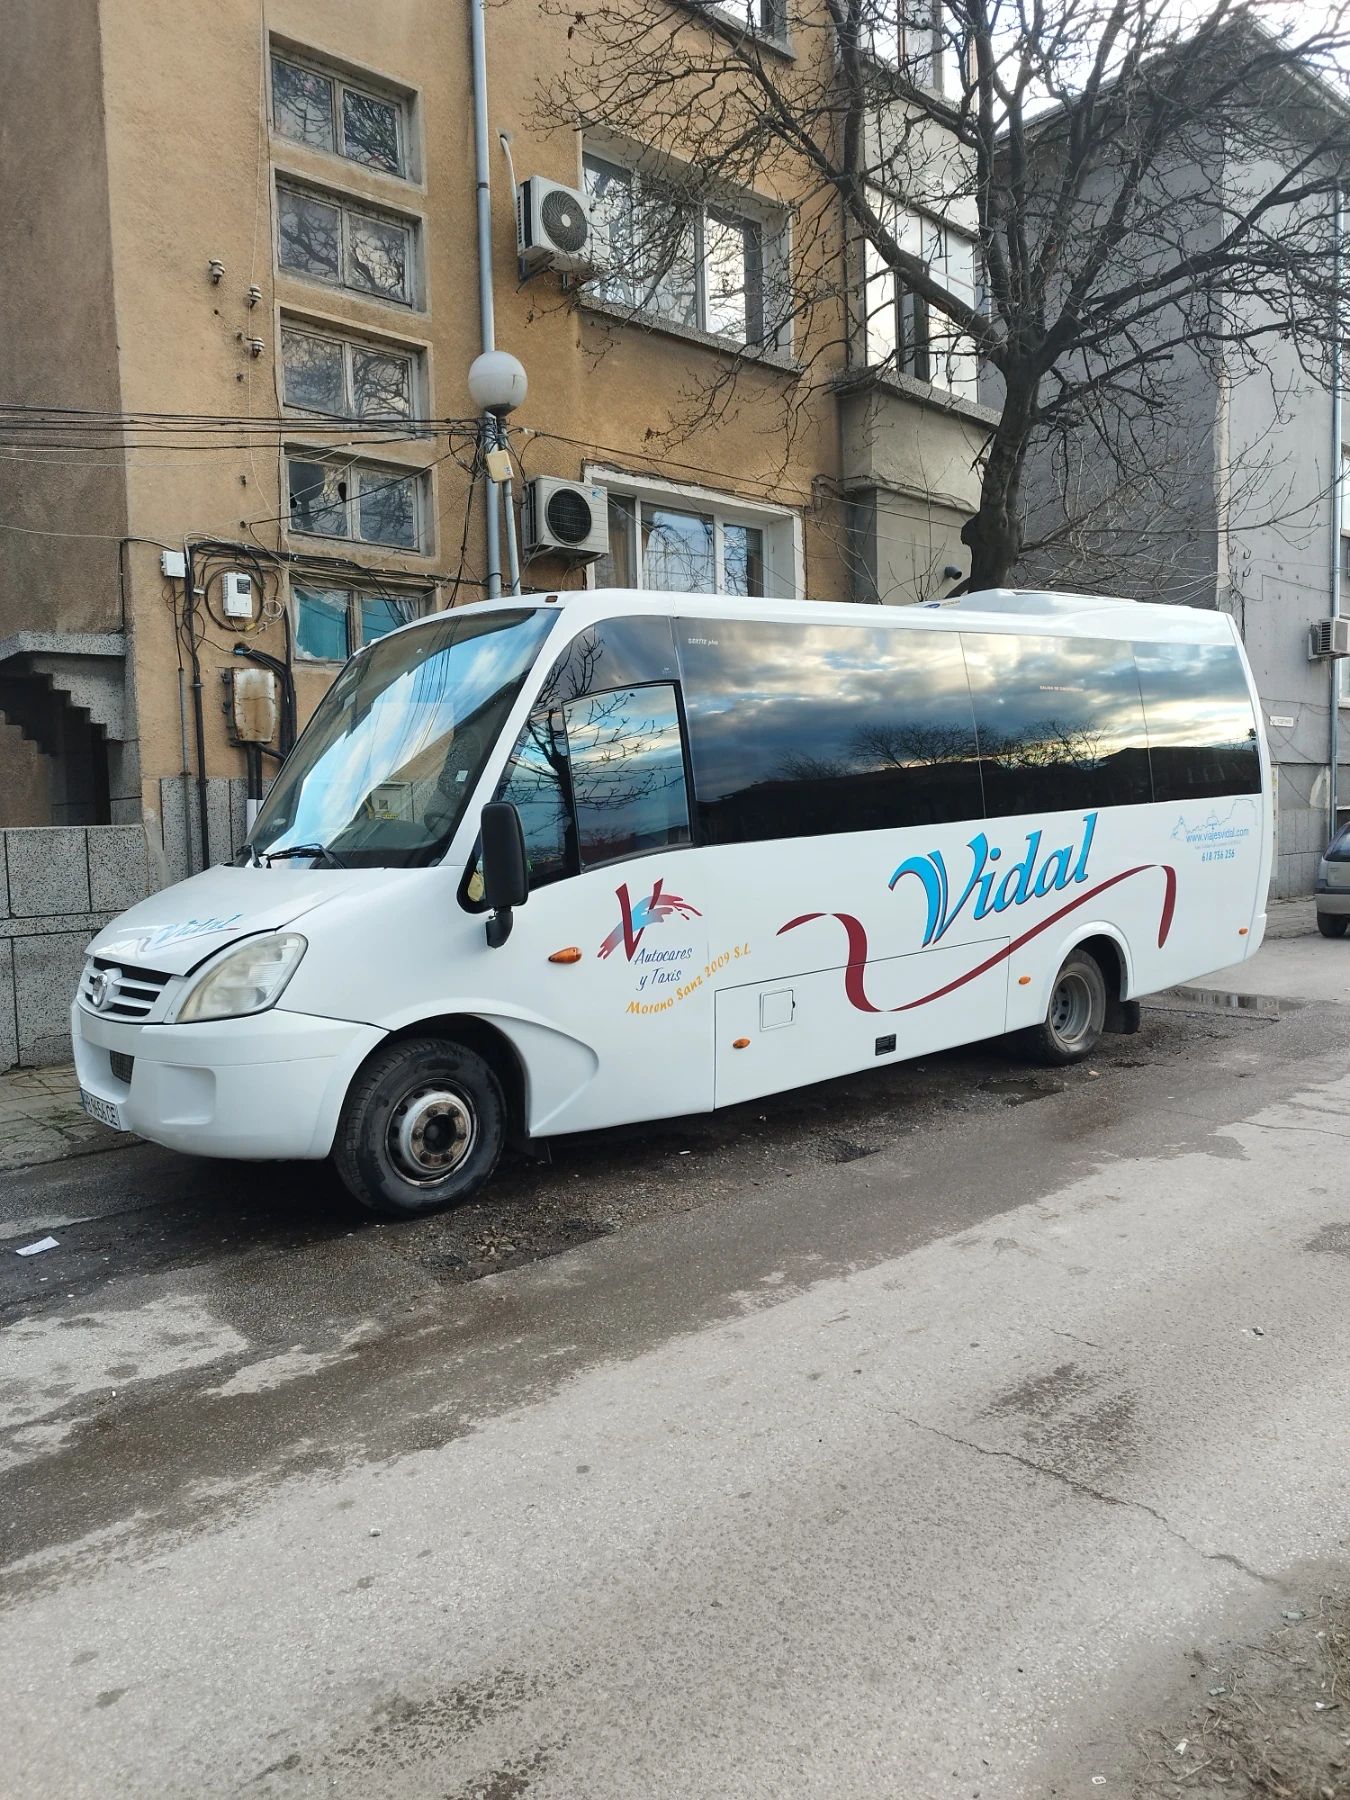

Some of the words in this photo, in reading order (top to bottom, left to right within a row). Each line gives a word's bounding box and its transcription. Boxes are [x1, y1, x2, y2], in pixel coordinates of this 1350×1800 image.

[1186, 828, 1250, 842] www.viajesvidal.com
[1201, 851, 1213, 862] 618
[888, 811, 1099, 949] Vidal
[634, 947, 693, 965] Autocares
[624, 997, 674, 1015] Moreno
[676, 975, 703, 1000] Sanz
[704, 951, 730, 978] 2009
[635, 973, 648, 991] y
[650, 966, 682, 985] Taxis
